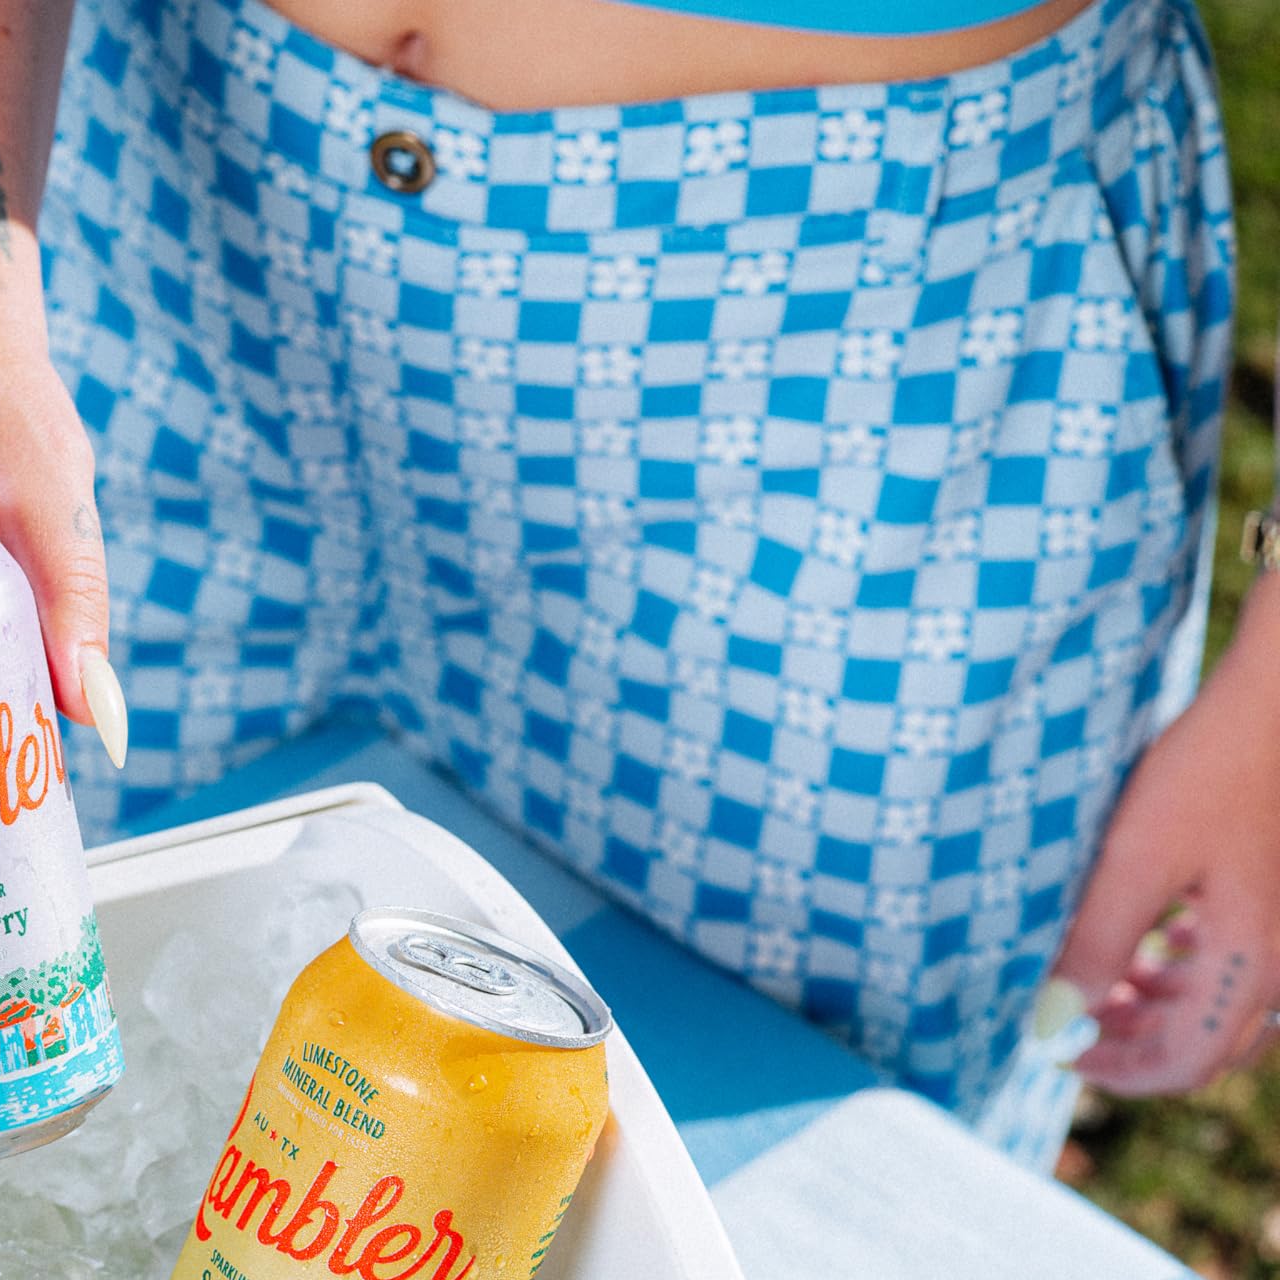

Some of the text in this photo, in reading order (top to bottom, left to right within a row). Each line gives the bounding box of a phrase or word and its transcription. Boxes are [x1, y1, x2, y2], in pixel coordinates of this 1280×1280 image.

[281, 1054, 386, 1140] MINERAL BLEND
[302, 1040, 380, 1106] LIMESTONE
[253, 1111, 300, 1161] AU TX
